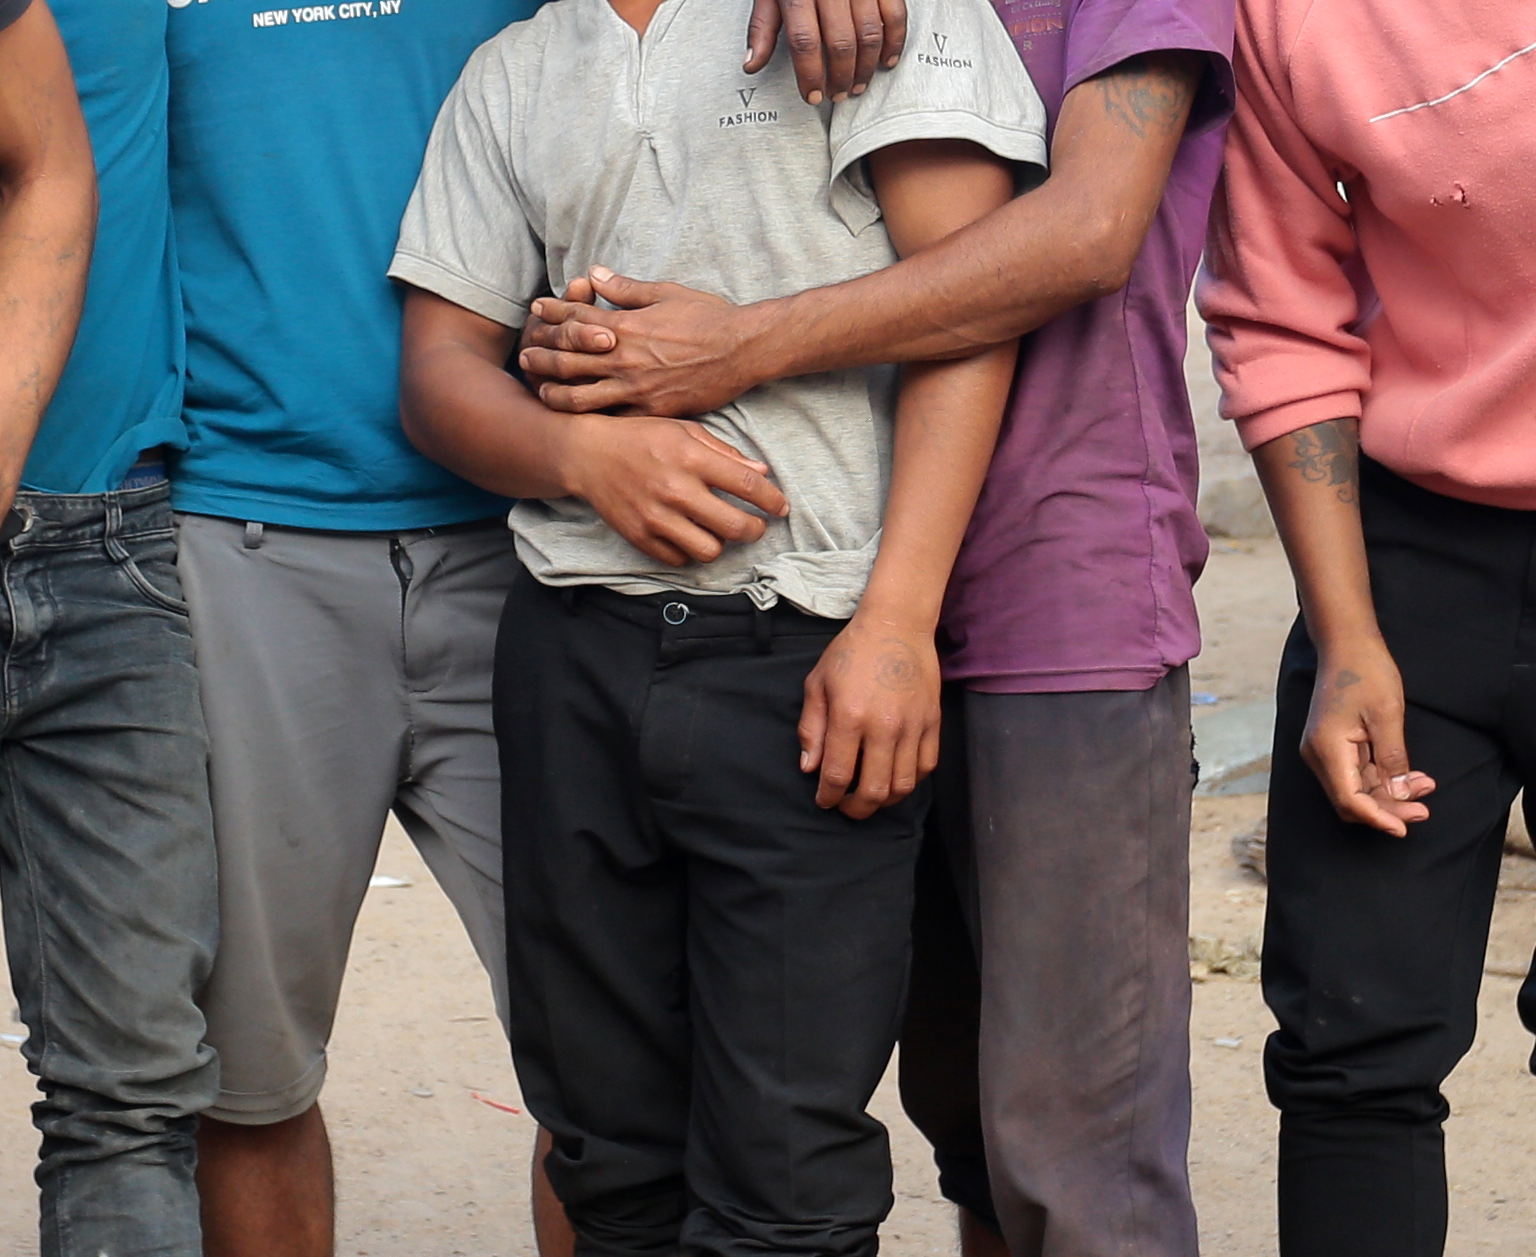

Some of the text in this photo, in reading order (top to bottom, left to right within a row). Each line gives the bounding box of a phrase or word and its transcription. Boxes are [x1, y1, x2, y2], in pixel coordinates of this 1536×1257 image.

[253, 0, 402, 28] NEW YORK CITY, NY
[933, 32, 948, 54] V
[917, 53, 973, 69] FASHION
[736, 87, 757, 108] V
[718, 110, 778, 128] FASHION
